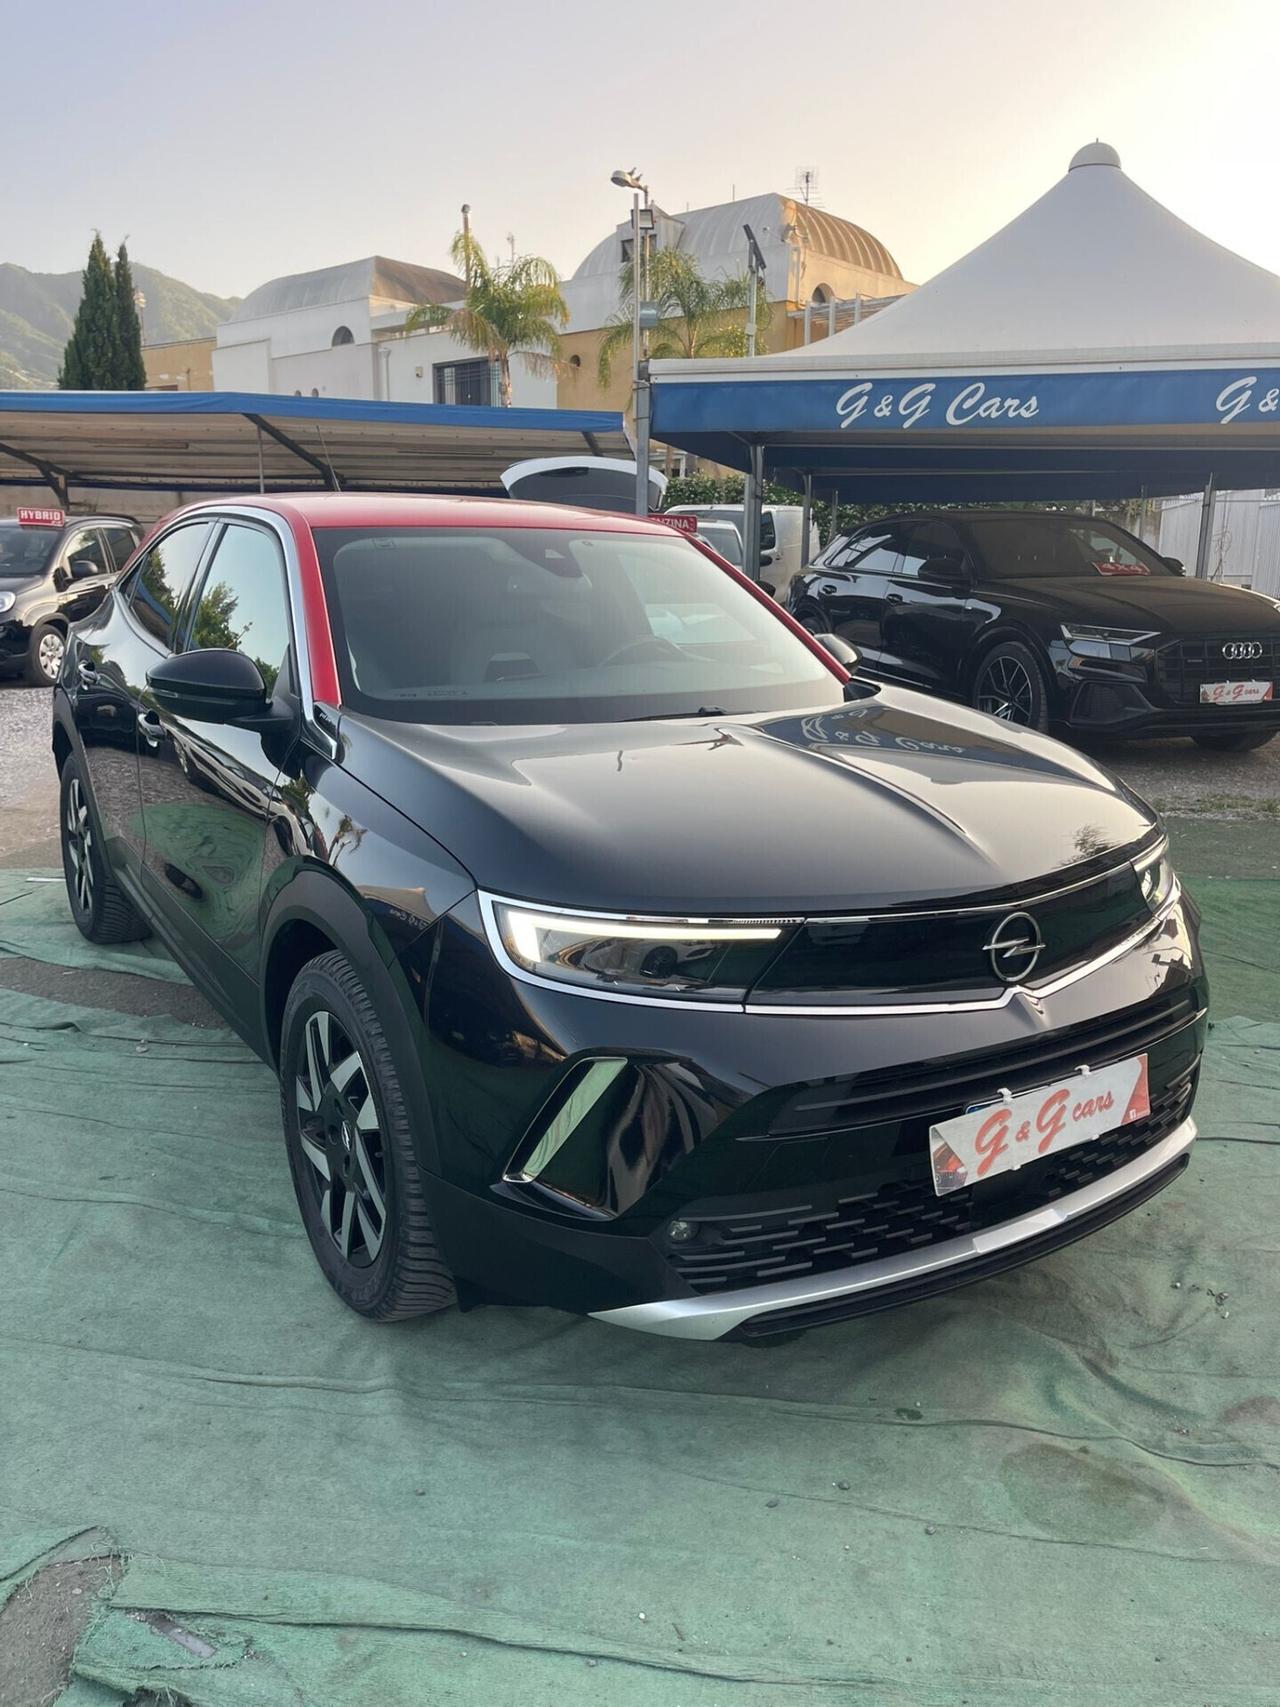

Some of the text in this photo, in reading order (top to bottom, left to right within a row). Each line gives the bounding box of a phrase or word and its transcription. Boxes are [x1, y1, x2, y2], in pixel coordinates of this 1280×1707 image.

[945, 382, 1040, 426] Cars
[20, 510, 61, 520] HYBRID
[1072, 1090, 1115, 1122] cars
